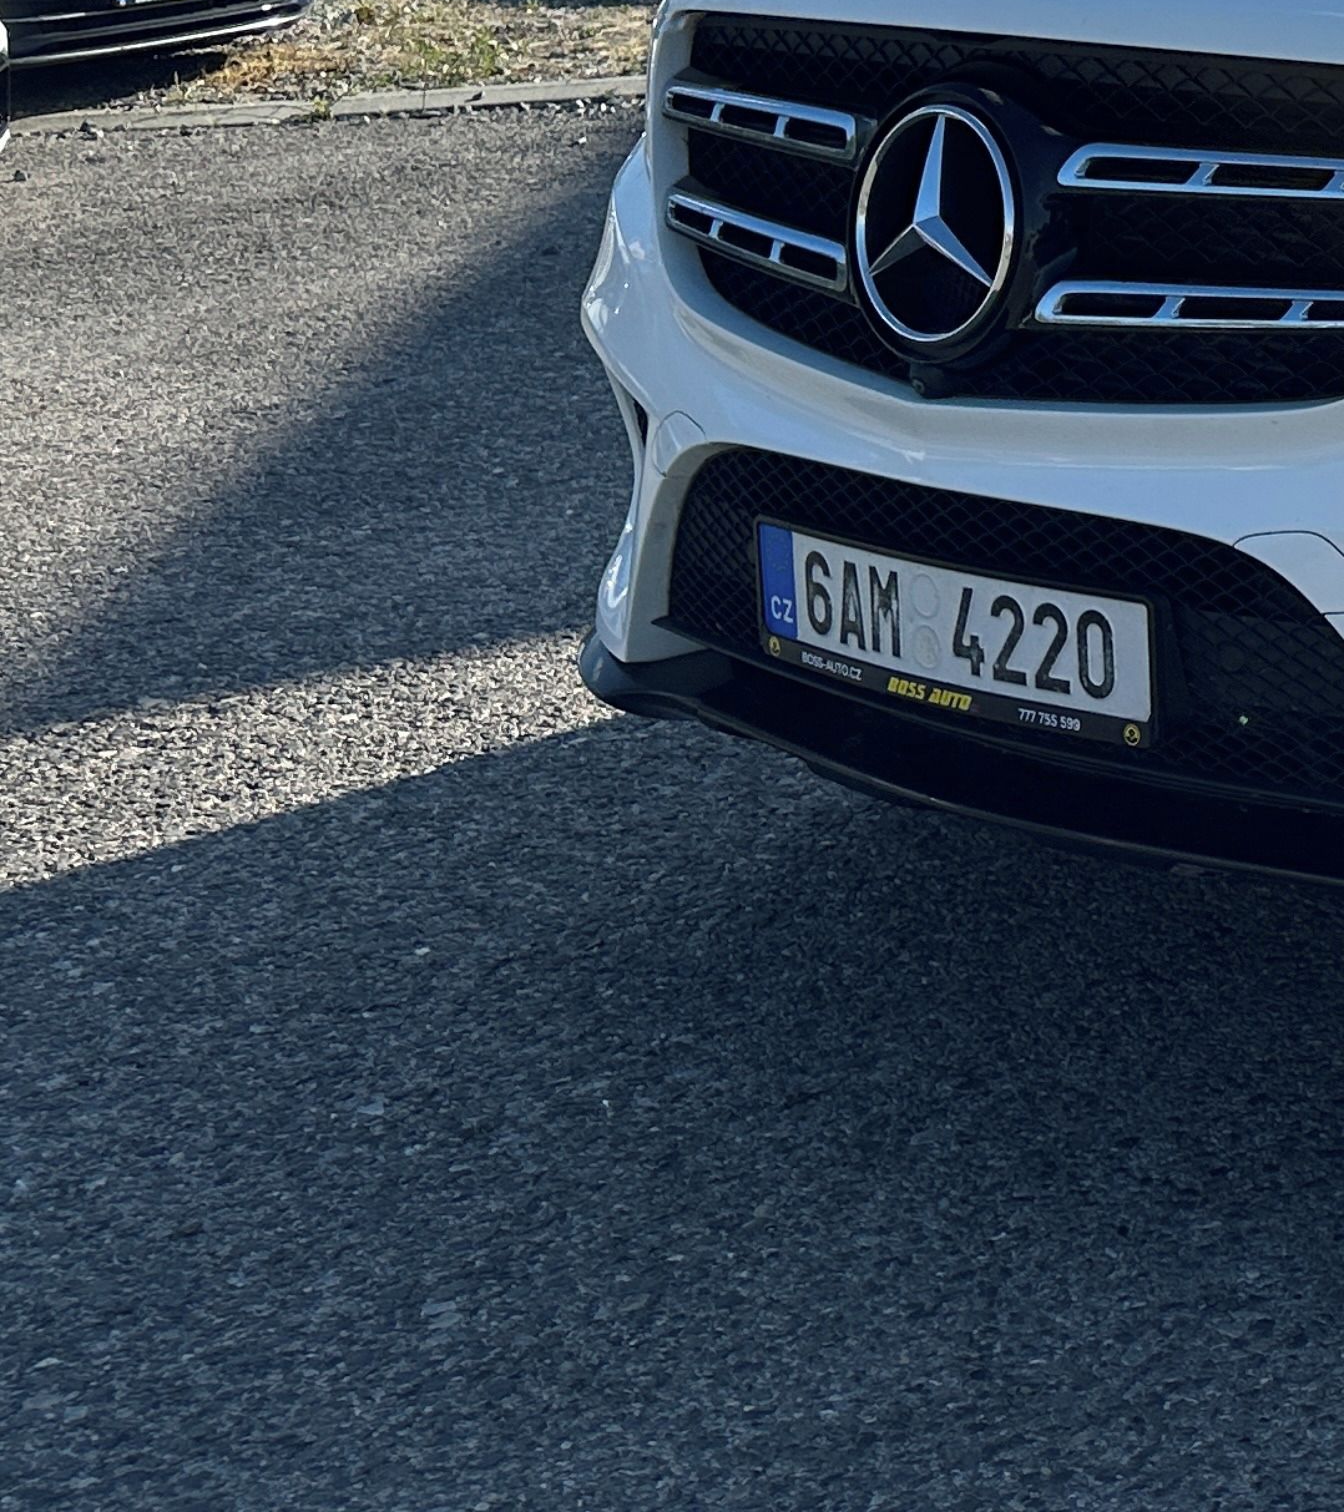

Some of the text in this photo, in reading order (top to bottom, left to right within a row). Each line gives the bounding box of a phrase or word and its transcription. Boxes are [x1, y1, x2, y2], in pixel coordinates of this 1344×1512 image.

[770, 550, 1115, 699] CZ 6AM 4220
[887, 676, 972, 713] BOSS AUTO
[1018, 708, 1081, 731] 777 755 599
